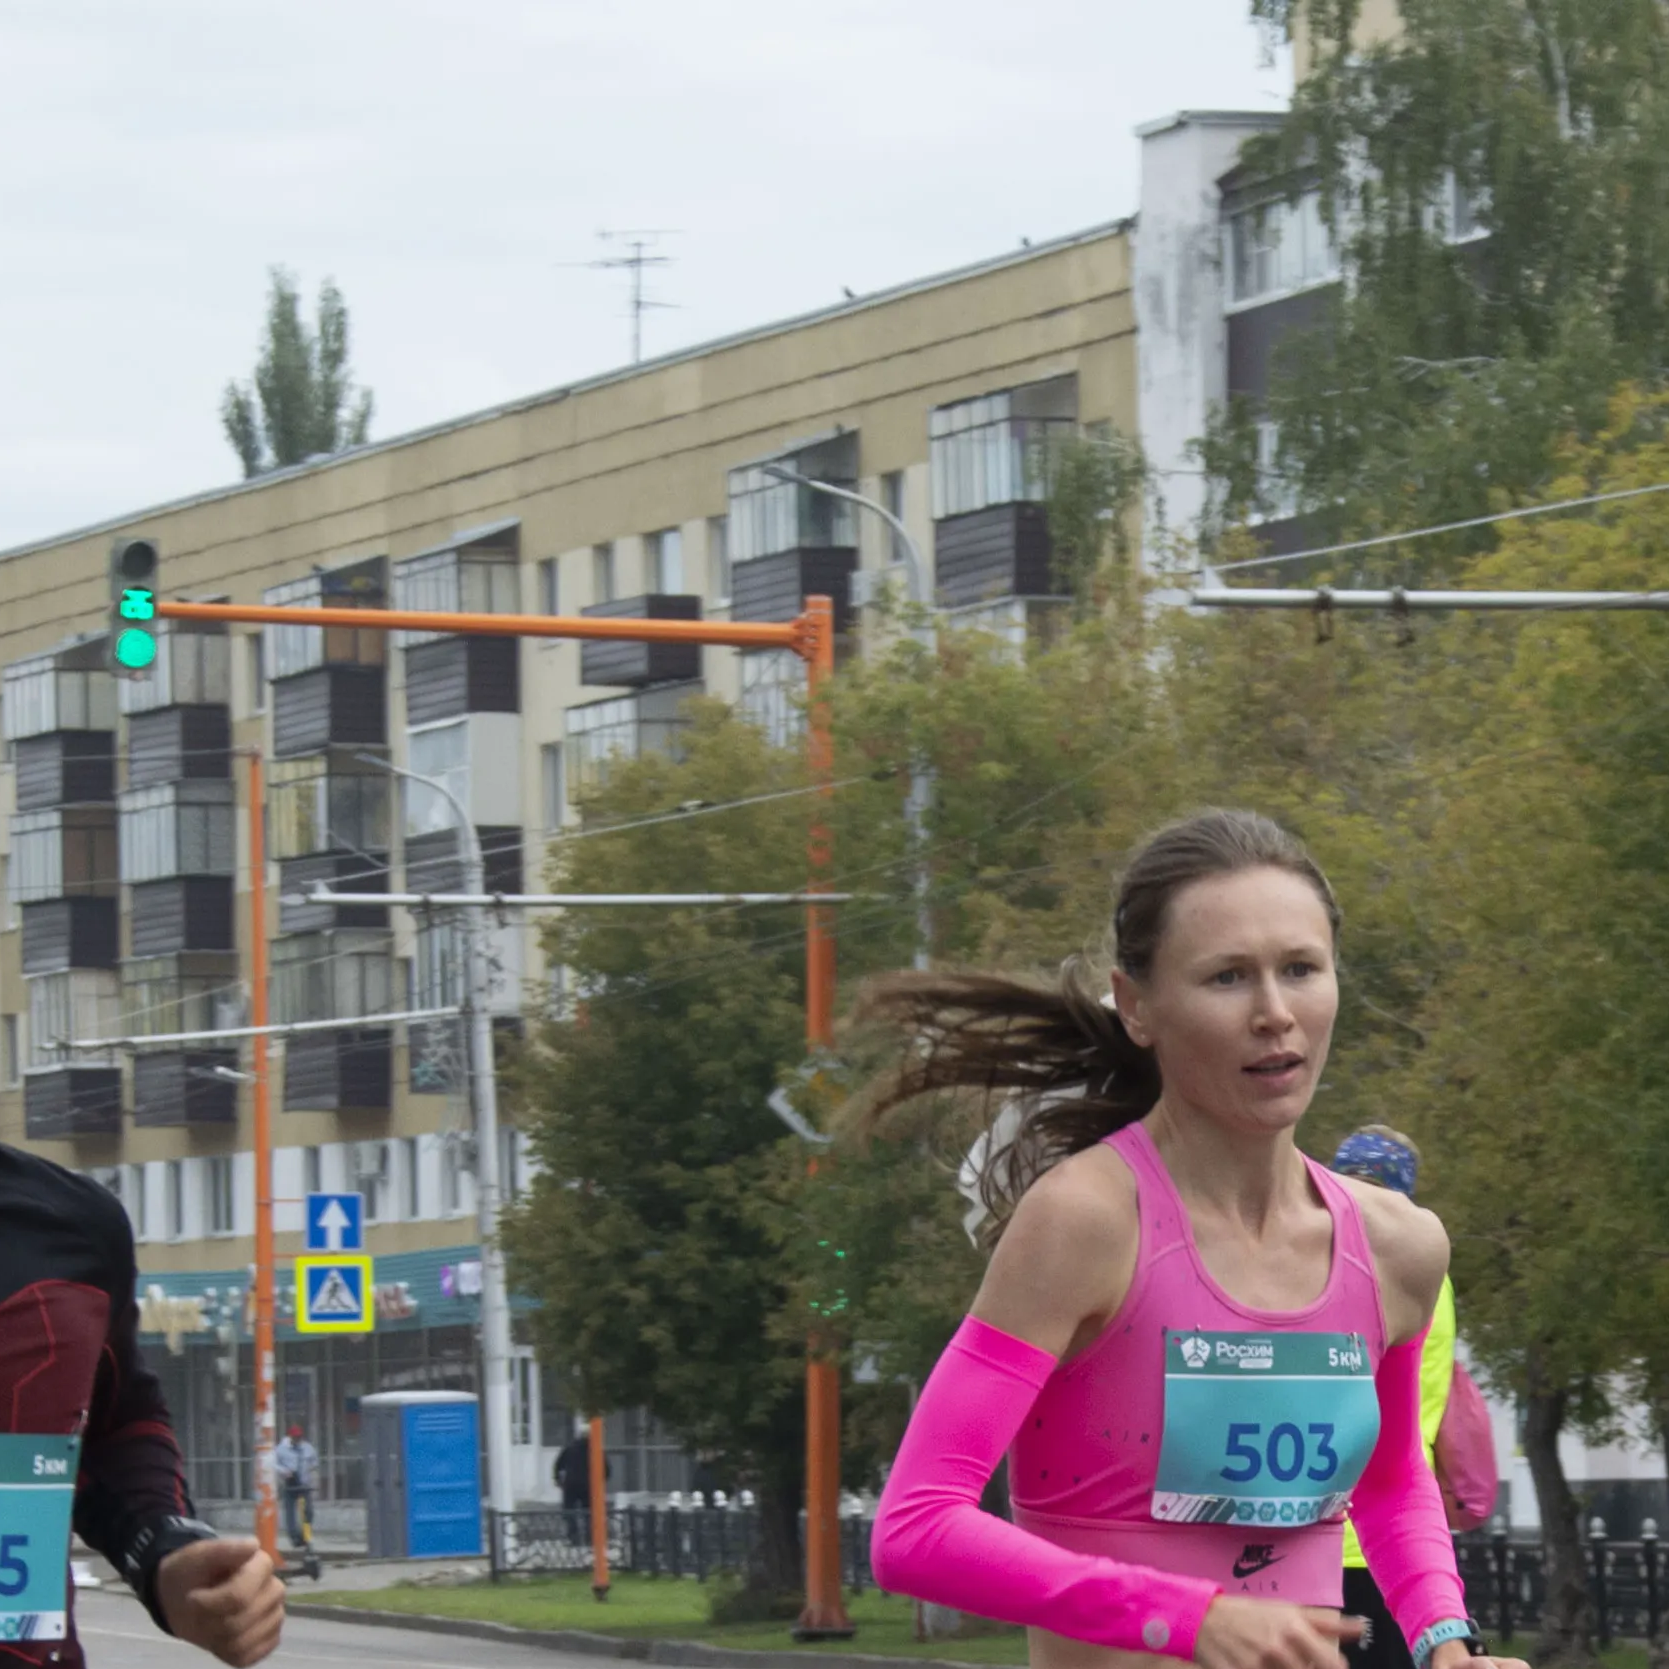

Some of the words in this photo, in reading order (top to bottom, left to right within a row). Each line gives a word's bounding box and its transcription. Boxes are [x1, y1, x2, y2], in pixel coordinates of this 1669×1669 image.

[1220, 1422, 1339, 1482] 503
[1240, 1544, 1275, 1563] NIKE
[1241, 1581, 1279, 1592] AIR
